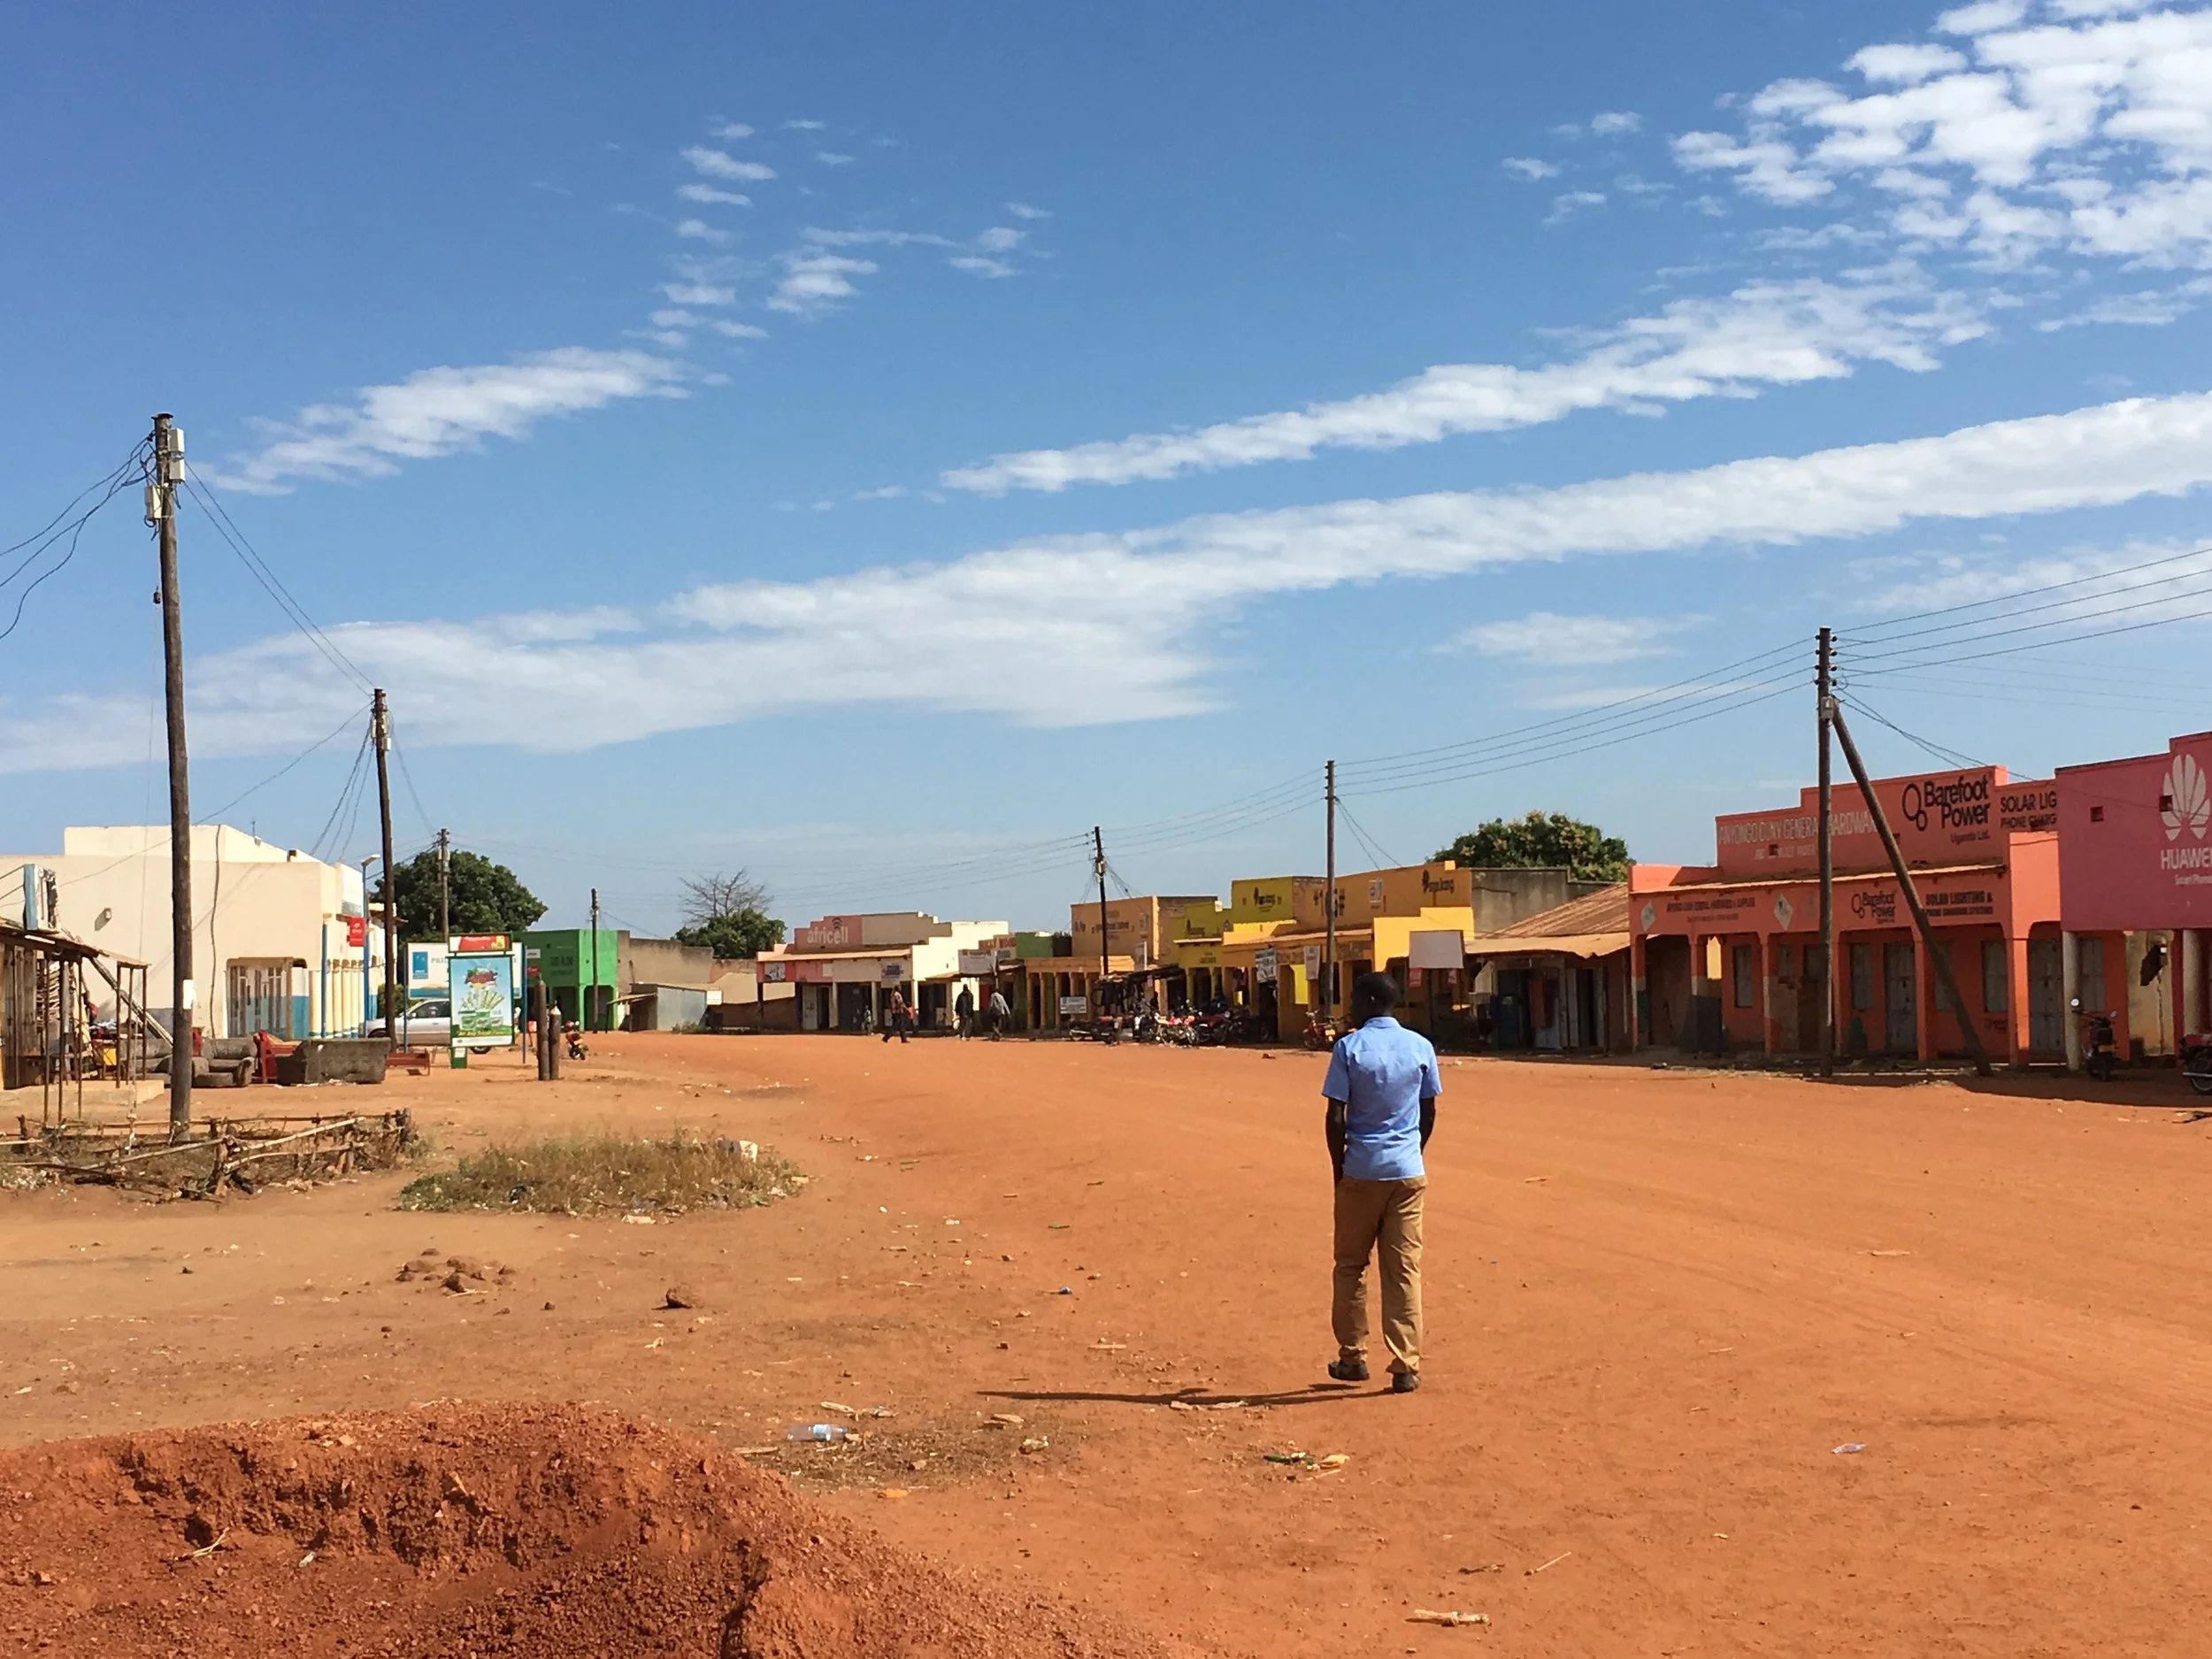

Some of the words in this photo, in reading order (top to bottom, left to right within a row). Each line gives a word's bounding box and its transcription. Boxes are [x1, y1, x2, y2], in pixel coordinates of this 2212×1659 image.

[1924, 774, 1989, 808] Barefoot
[2000, 794, 2036, 813] SOLAR
[1783, 816, 1819, 840] GENERA
[1940, 803, 1990, 829] Power
[806, 926, 849, 944] africell
